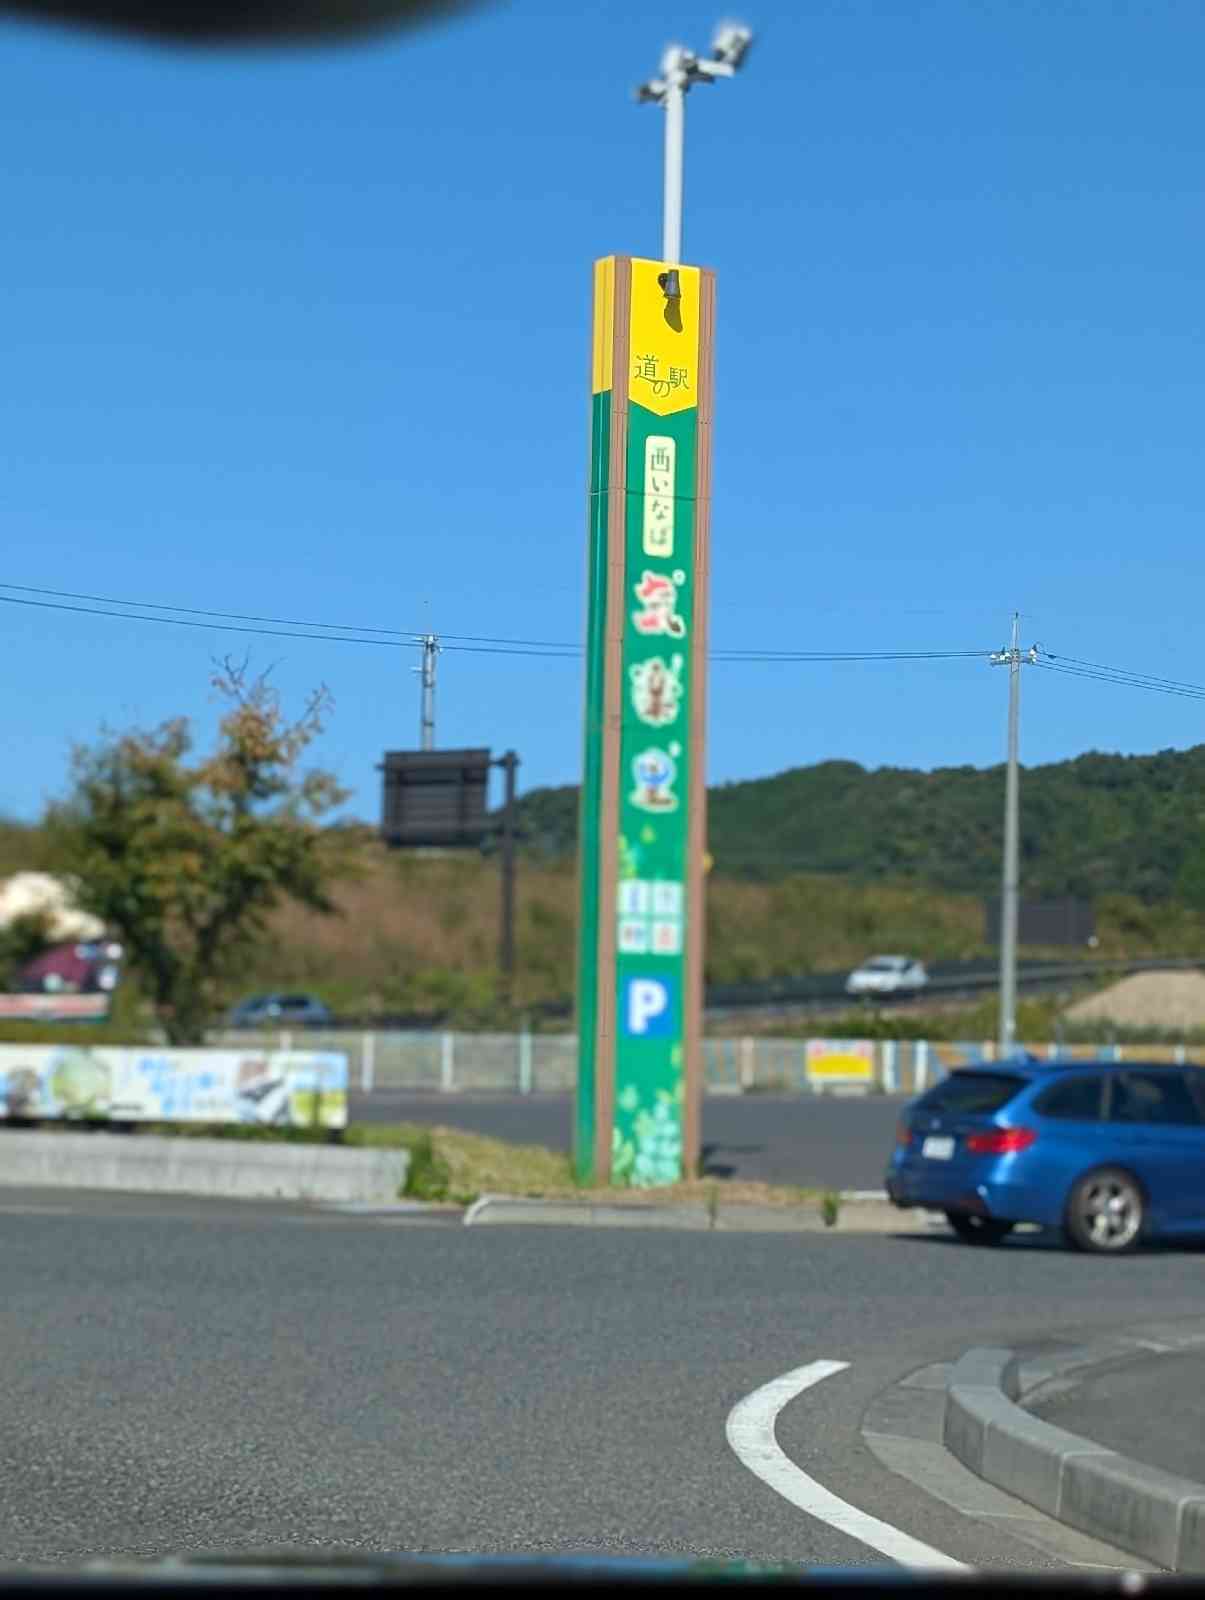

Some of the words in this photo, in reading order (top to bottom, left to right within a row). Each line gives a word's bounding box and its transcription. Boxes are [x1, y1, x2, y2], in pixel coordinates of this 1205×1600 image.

[633, 354, 690, 398] 道の駅
[627, 980, 668, 1035] P
